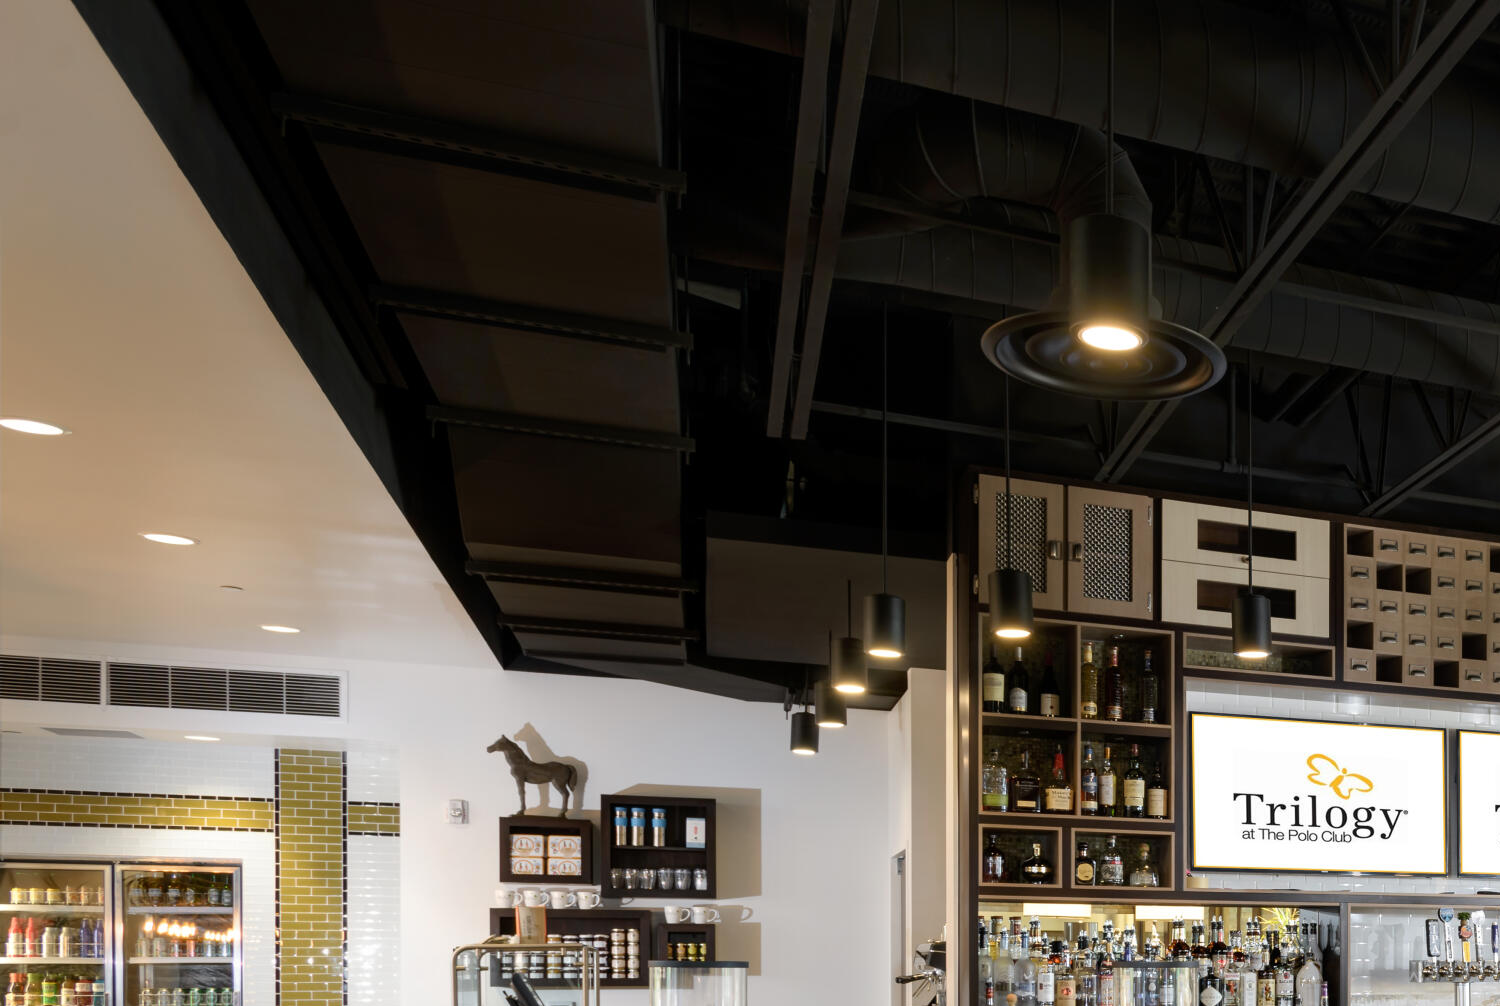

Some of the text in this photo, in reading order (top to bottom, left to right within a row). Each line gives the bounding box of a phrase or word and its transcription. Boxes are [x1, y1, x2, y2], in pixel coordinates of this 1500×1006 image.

[1233, 793, 1404, 840] Trilogy
[1242, 828, 1352, 843] at The Polo Club
